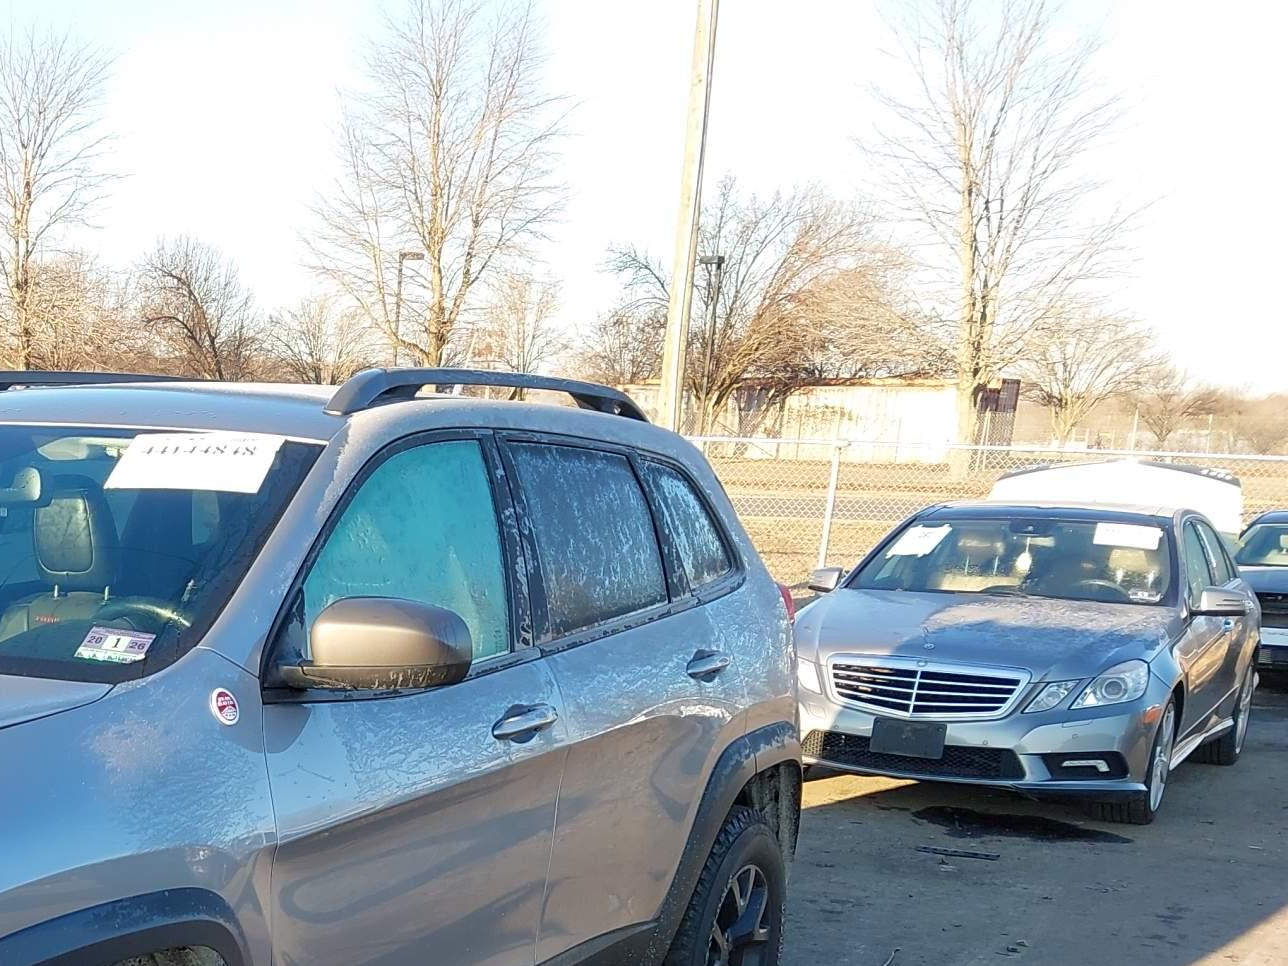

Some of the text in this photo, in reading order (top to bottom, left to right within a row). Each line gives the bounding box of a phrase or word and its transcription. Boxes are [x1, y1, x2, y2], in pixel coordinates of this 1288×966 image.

[87, 635, 146, 650] 20 1 26
